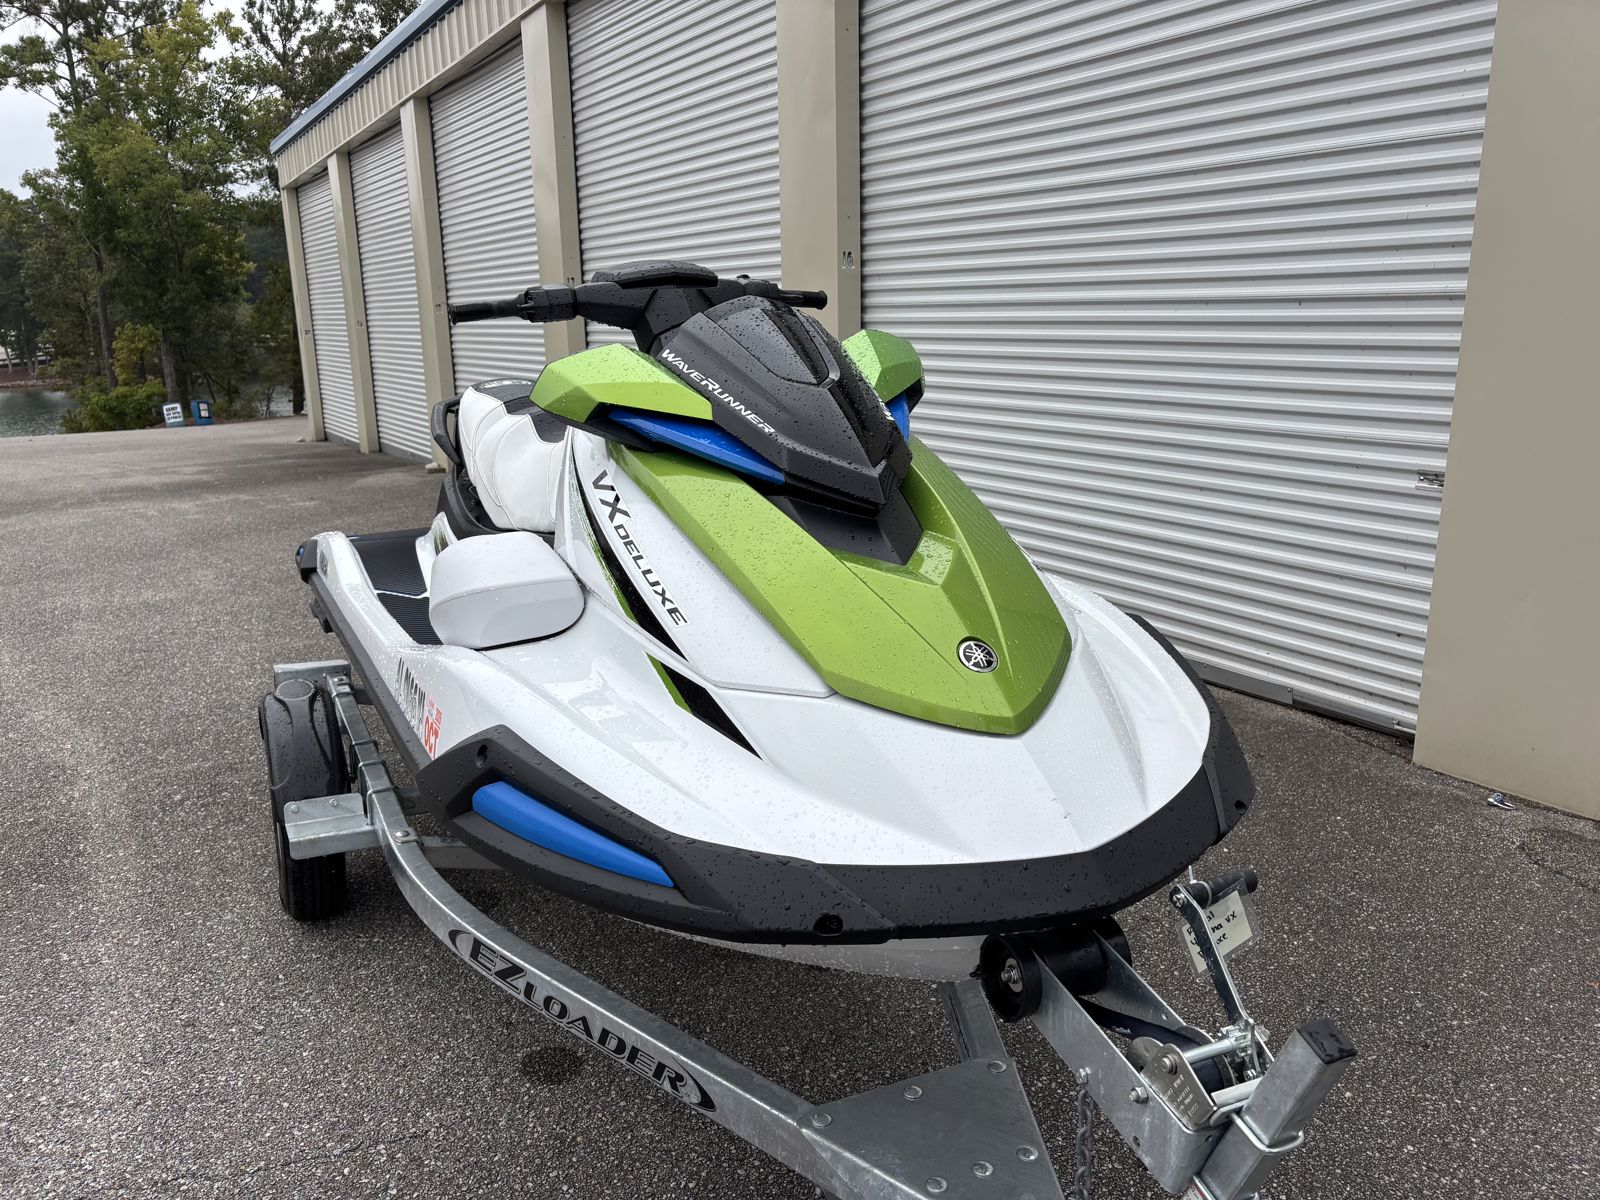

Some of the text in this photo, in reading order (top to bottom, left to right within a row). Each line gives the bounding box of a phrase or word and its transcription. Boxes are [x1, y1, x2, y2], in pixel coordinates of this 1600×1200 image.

[842, 251, 854, 267] 16
[661, 348, 776, 434] WAVERUNNER
[592, 469, 688, 626] VX DELUXE
[1225, 910, 1238, 923] VX
